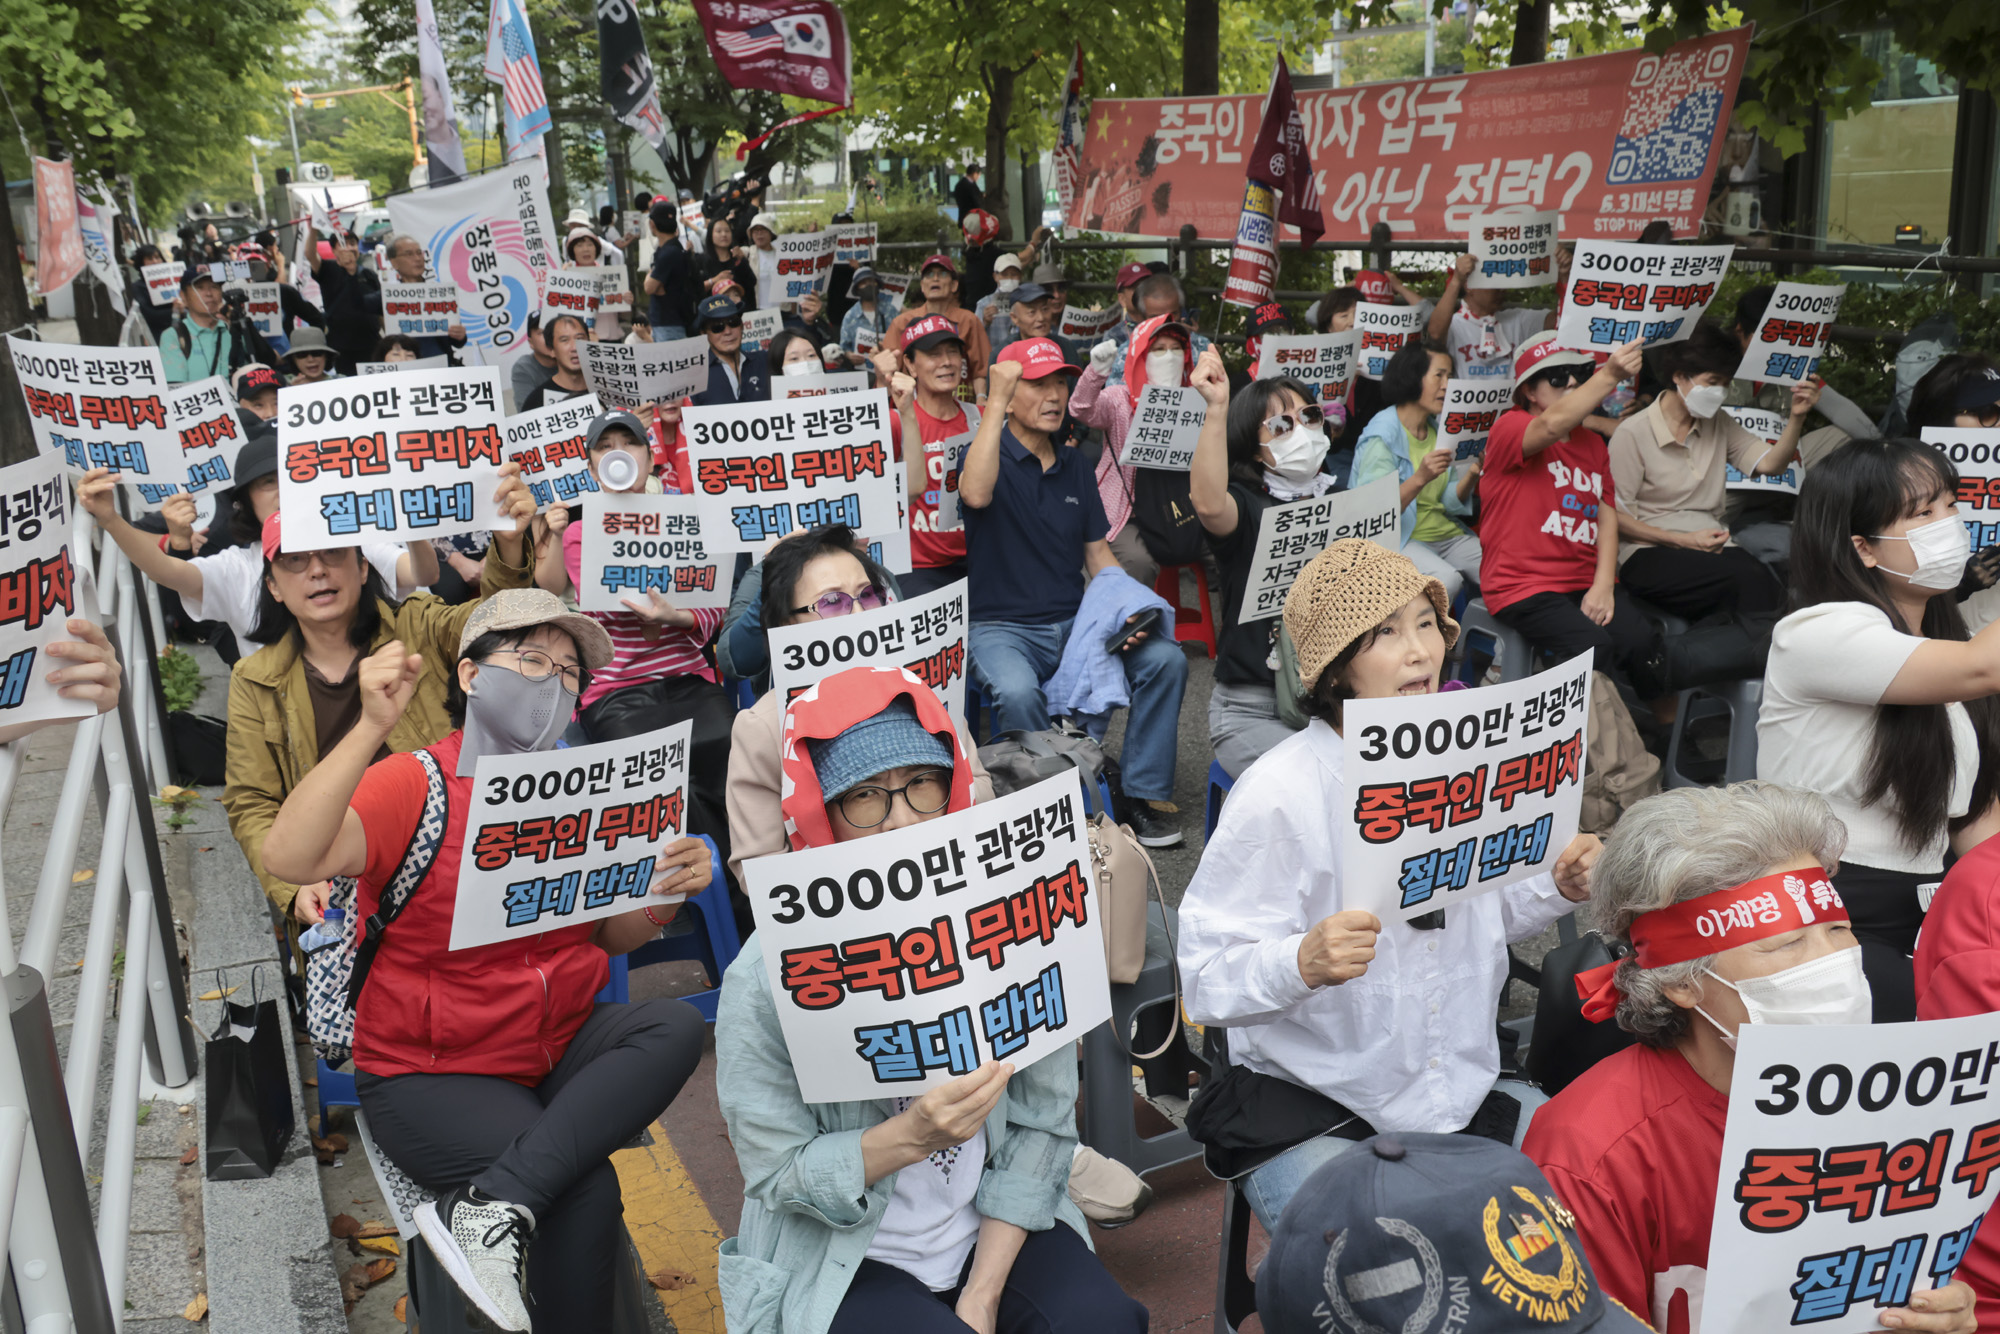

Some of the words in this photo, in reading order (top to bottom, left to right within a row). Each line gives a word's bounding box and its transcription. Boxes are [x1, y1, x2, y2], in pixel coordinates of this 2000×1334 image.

[1154, 99, 1247, 165] 중국인
[1377, 79, 1469, 156] 입국
[1108, 188, 1143, 216] PASSED
[1332, 163, 1432, 235] 아닌
[1482, 226, 1521, 241] 중국인
[1523, 223, 1552, 239] 관광객
[1594, 217, 1626, 232] STOP
[781, 239, 820, 252] 3000만
[1233, 247, 1268, 267] CHINESE
[1489, 240, 1547, 255] 3000만명
[777, 257, 814, 275] 중국인
[1481, 259, 1527, 277] 무비자
[1580, 252, 1667, 276] 3000만
[1670, 254, 1726, 277] 관광객
[385, 286, 426, 298] 3000만
[550, 276, 591, 291] 3000만
[1227, 276, 1267, 297] SECURITY
[1572, 279, 1650, 312] 중국인
[1650, 281, 1716, 312] 무비자
[547, 291, 585, 311] 중국인
[1775, 293, 1832, 315] 3000만
[905, 319, 934, 340] 이재명
[1359, 311, 1413, 328] 3000만
[1589, 317, 1641, 345] 절대
[1641, 316, 1685, 346] 반대
[1760, 318, 1821, 348] 중국인
[586, 344, 634, 361] 중국인
[589, 360, 637, 377] 관광객
[642, 354, 706, 377] 유치보다
[1275, 348, 1317, 364] 중국인
[1319, 343, 1354, 362] 관광객
[1765, 352, 1808, 381] 절대
[14, 351, 80, 384] 3000만
[83, 359, 157, 385] 관광객
[1281, 362, 1347, 379] 3000만명
[594, 375, 640, 395] 자국민
[1148, 388, 1184, 406] 중국인
[1322, 378, 1349, 400] 반대
[1451, 387, 1511, 404] 3000만
[23, 383, 79, 427] 중국인
[80, 395, 167, 430] 무비자
[287, 387, 400, 428] 3000만
[409, 381, 496, 417] 관광객
[545, 404, 596, 434] 관광객
[1142, 407, 1178, 427] 관광객
[1181, 410, 1206, 427] 유치
[693, 412, 795, 445] 3000만
[803, 403, 881, 438] 관광객
[1136, 427, 1174, 444] 자국민
[1445, 409, 1496, 434] 중국인
[88, 441, 151, 474] 반대
[286, 431, 390, 483] 중국인
[395, 423, 503, 472] 무비자
[698, 452, 788, 495] 중국인
[792, 440, 887, 488] 무비자
[1130, 446, 1167, 464] 안전이
[553, 468, 600, 501] 반대
[320, 488, 397, 535] 절대
[400, 482, 474, 529] 반대
[731, 502, 793, 542] 절대
[797, 493, 862, 533] 반대
[1274, 500, 1333, 533] 중국인
[602, 512, 660, 536] 중국인
[1269, 528, 1329, 560] 관광객
[1332, 508, 1396, 541] 유치보다
[601, 565, 672, 594] 무비자
[674, 565, 717, 592] 반대
[783, 619, 905, 671] 3000만
[911, 594, 963, 646] 관광객
[1359, 702, 1515, 762] 3000만
[1519, 671, 1587, 738] 관광객
[484, 758, 616, 806] 3000만
[622, 738, 685, 790] 관광객
[1354, 763, 1489, 844] 중국인
[1489, 727, 1583, 812] 무비자
[472, 809, 593, 871] 중국인
[594, 785, 684, 851] 무비자
[768, 838, 968, 925] 3000만
[976, 793, 1077, 880] 관광객
[1398, 836, 1478, 909] 절대
[1477, 812, 1554, 883] 반대
[502, 870, 582, 928] 절대
[583, 855, 657, 910] 반대
[1696, 891, 1782, 937] 이재명
[780, 914, 964, 1010] 중국인
[965, 859, 1088, 972] 무비자
[854, 1005, 982, 1084] 절대
[979, 961, 1067, 1061] 반대
[1754, 1040, 2000, 1116] 3000만
[1734, 1127, 1954, 1235] 중국인
[1481, 1265, 1570, 1323] VIETNAM
[1790, 1233, 1928, 1326] 절대
